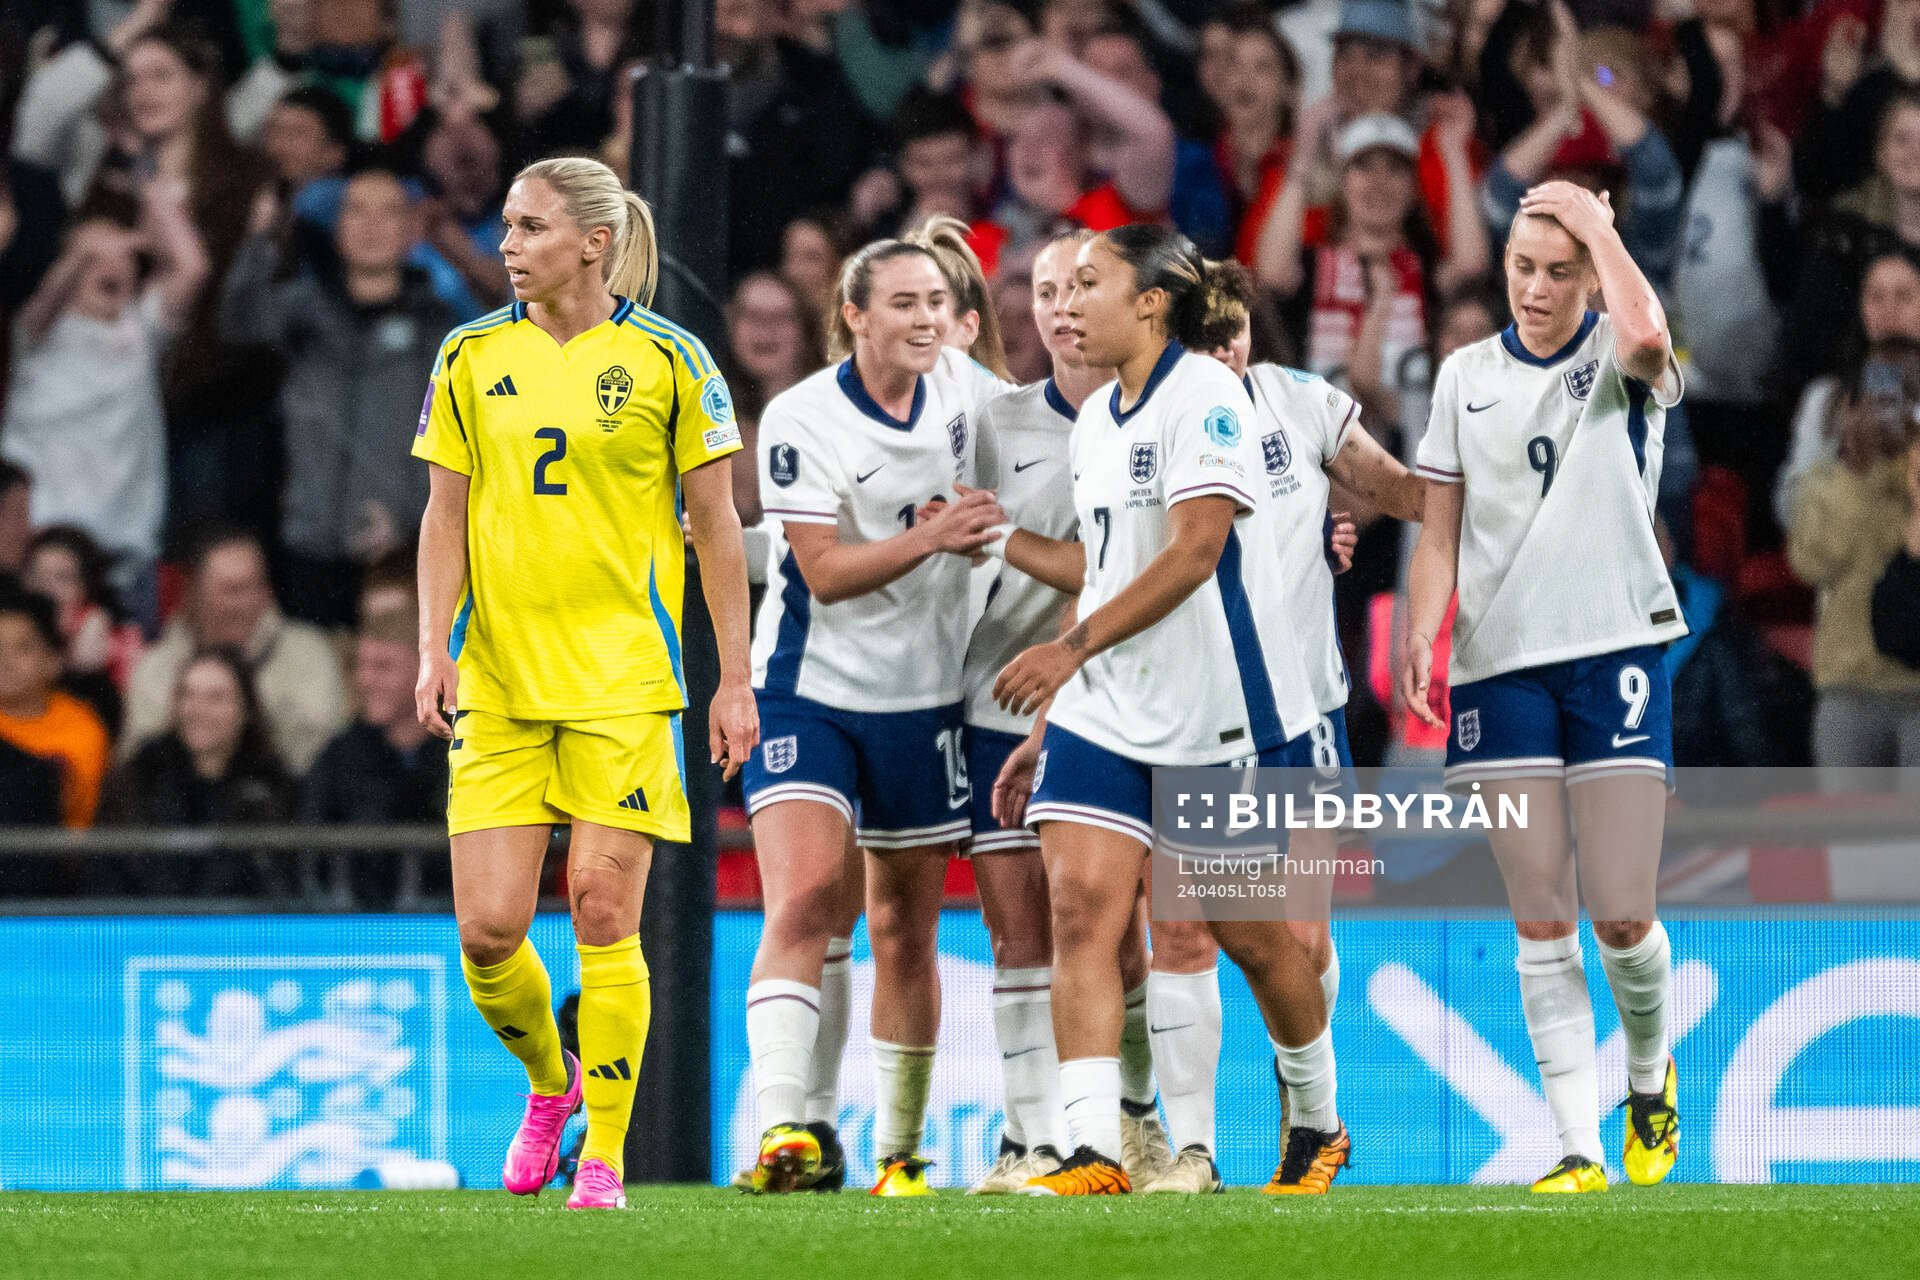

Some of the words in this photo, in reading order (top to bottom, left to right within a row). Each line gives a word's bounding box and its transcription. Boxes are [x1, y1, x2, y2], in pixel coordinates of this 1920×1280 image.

[534, 427, 567, 496] 2
[1130, 488, 1153, 498] SWEDEN
[1270, 474, 1295, 489] SWEDEN
[1528, 436, 1559, 499] 9
[1130, 499, 1145, 508] APRIL
[1094, 507, 1112, 571] 7
[1620, 666, 1650, 729] 9
[1310, 714, 1341, 779] 8
